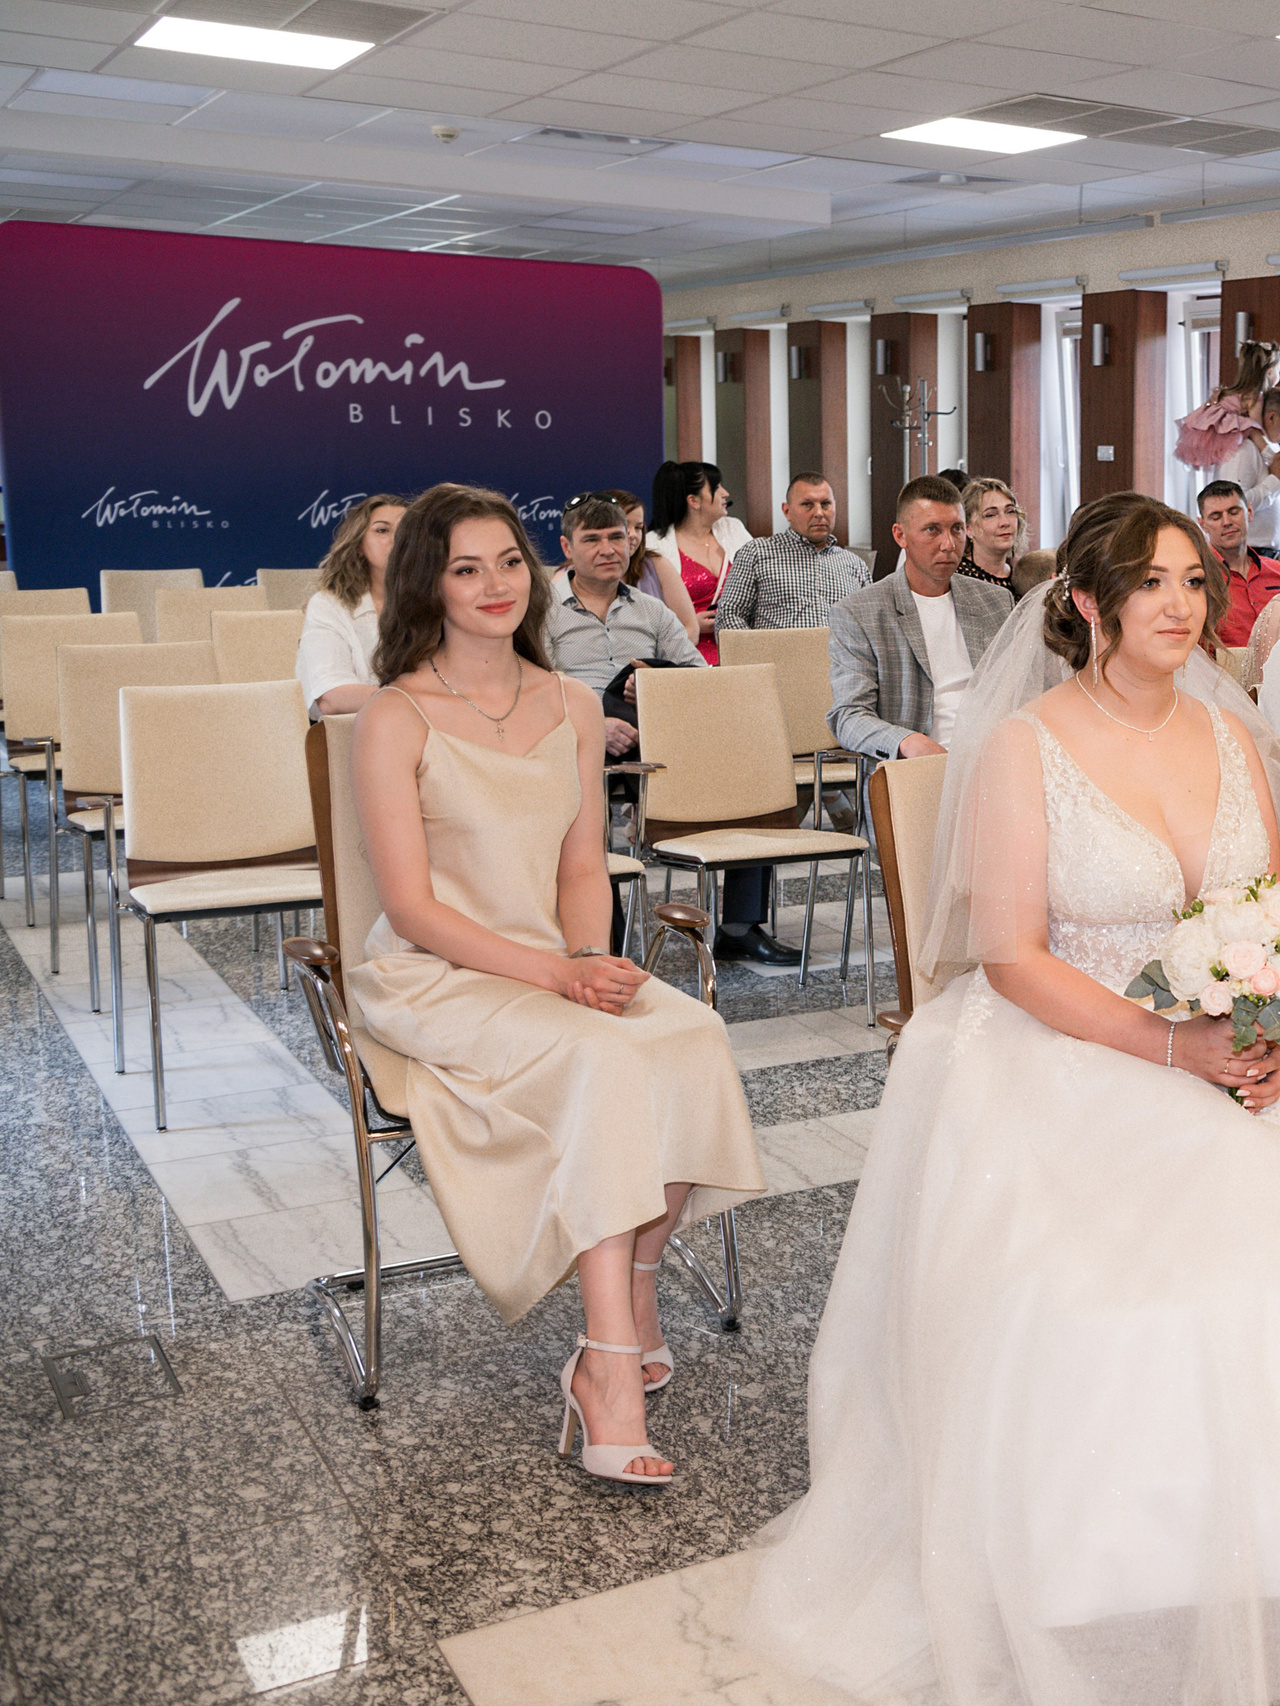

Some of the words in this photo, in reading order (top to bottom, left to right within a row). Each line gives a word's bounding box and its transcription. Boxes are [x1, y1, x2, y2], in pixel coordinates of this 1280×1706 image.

[143, 297, 507, 417] Wołomin
[348, 403, 553, 430] BLISKO
[81, 486, 212, 528] Wołomin
[152, 520, 230, 529] BLISKO
